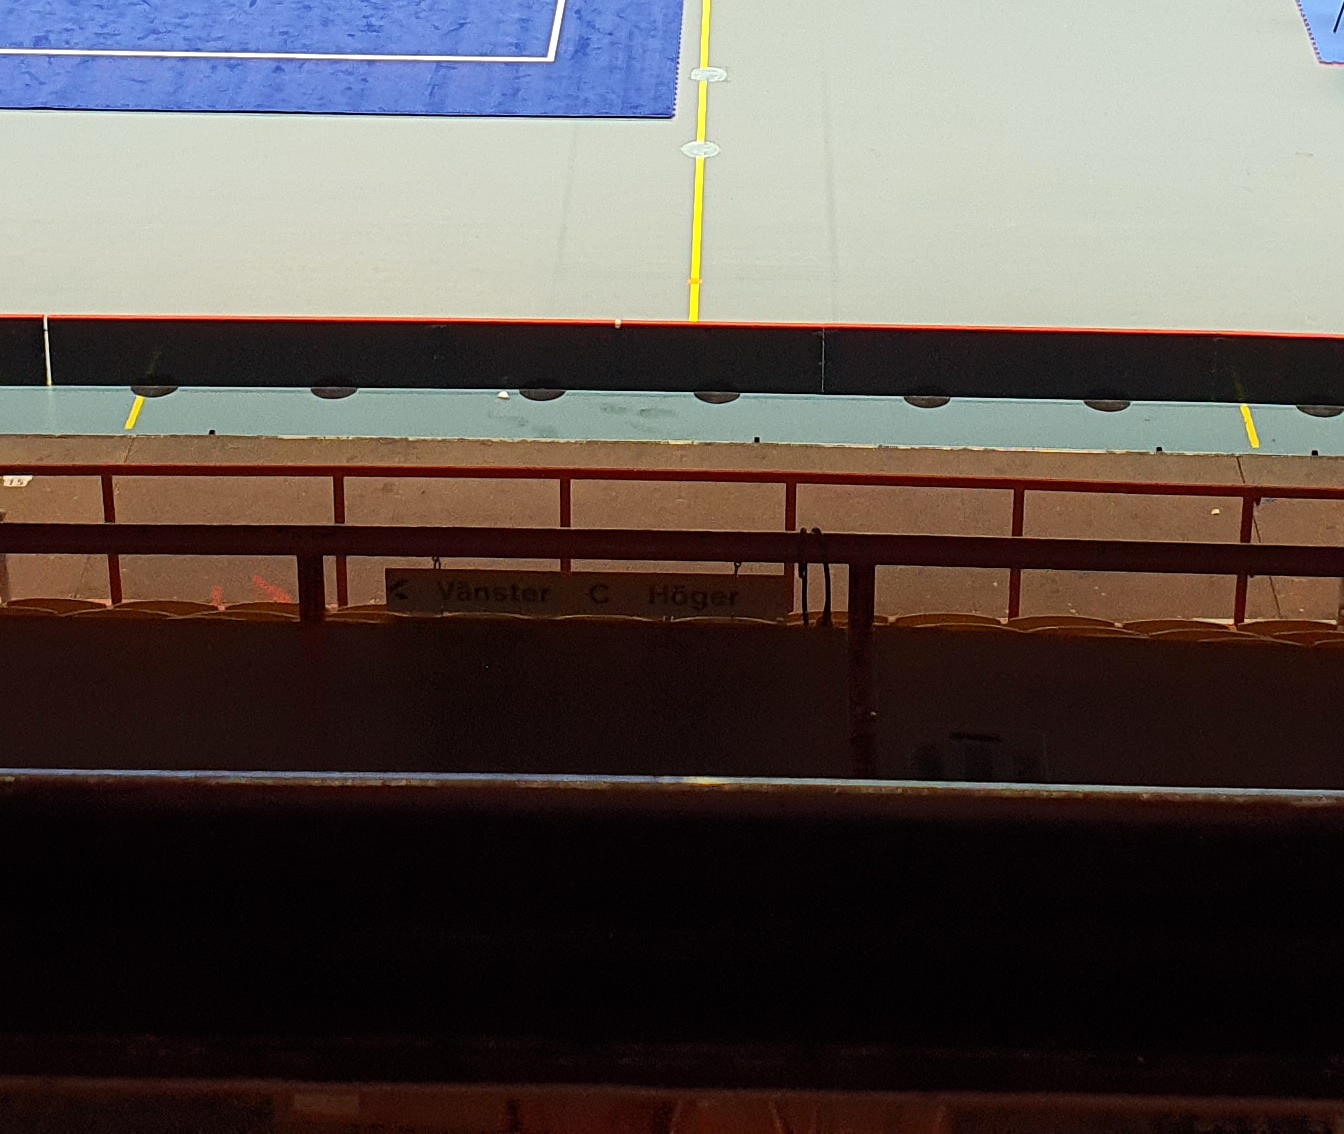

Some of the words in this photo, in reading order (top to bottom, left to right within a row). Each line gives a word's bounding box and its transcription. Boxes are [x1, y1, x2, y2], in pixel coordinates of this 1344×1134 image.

[437, 578, 552, 604] Vänster
[588, 583, 610, 605] C
[648, 581, 741, 611] Höger
